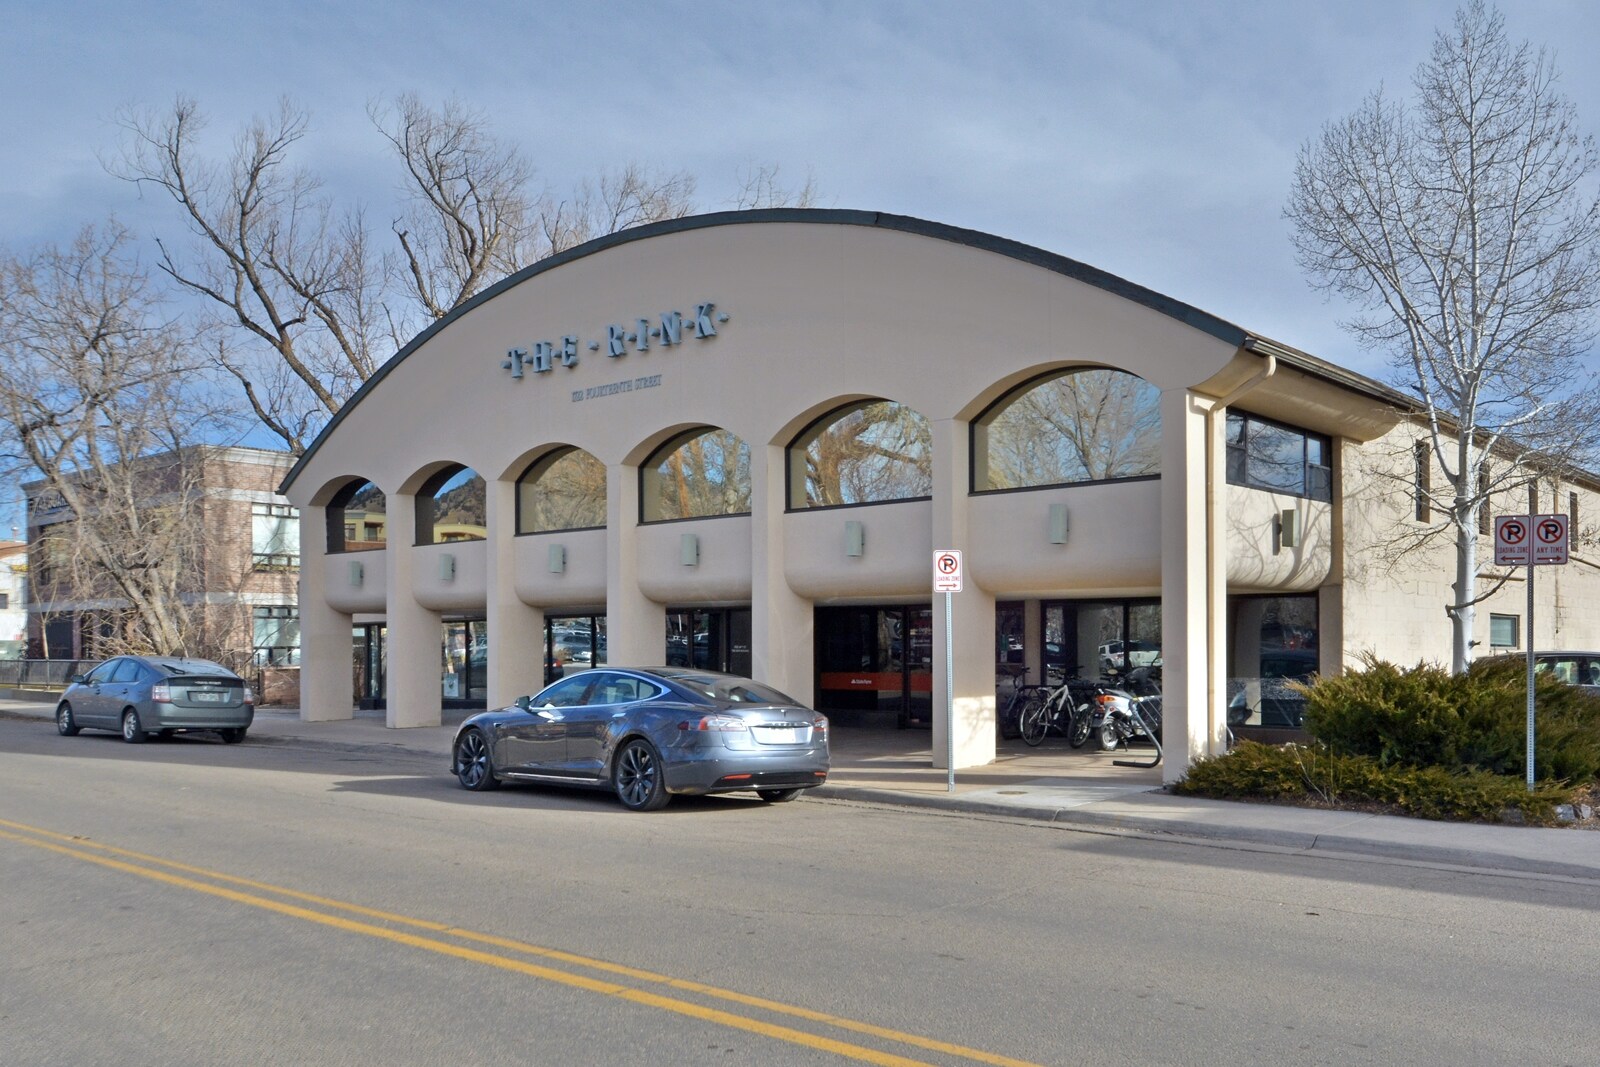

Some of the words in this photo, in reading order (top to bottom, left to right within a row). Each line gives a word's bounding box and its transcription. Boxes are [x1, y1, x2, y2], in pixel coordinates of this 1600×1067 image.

[507, 335, 579, 378] THE
[607, 302, 718, 357] RINK
[586, 380, 633, 400] FOURTEENTH
[635, 374, 662, 391] STREET
